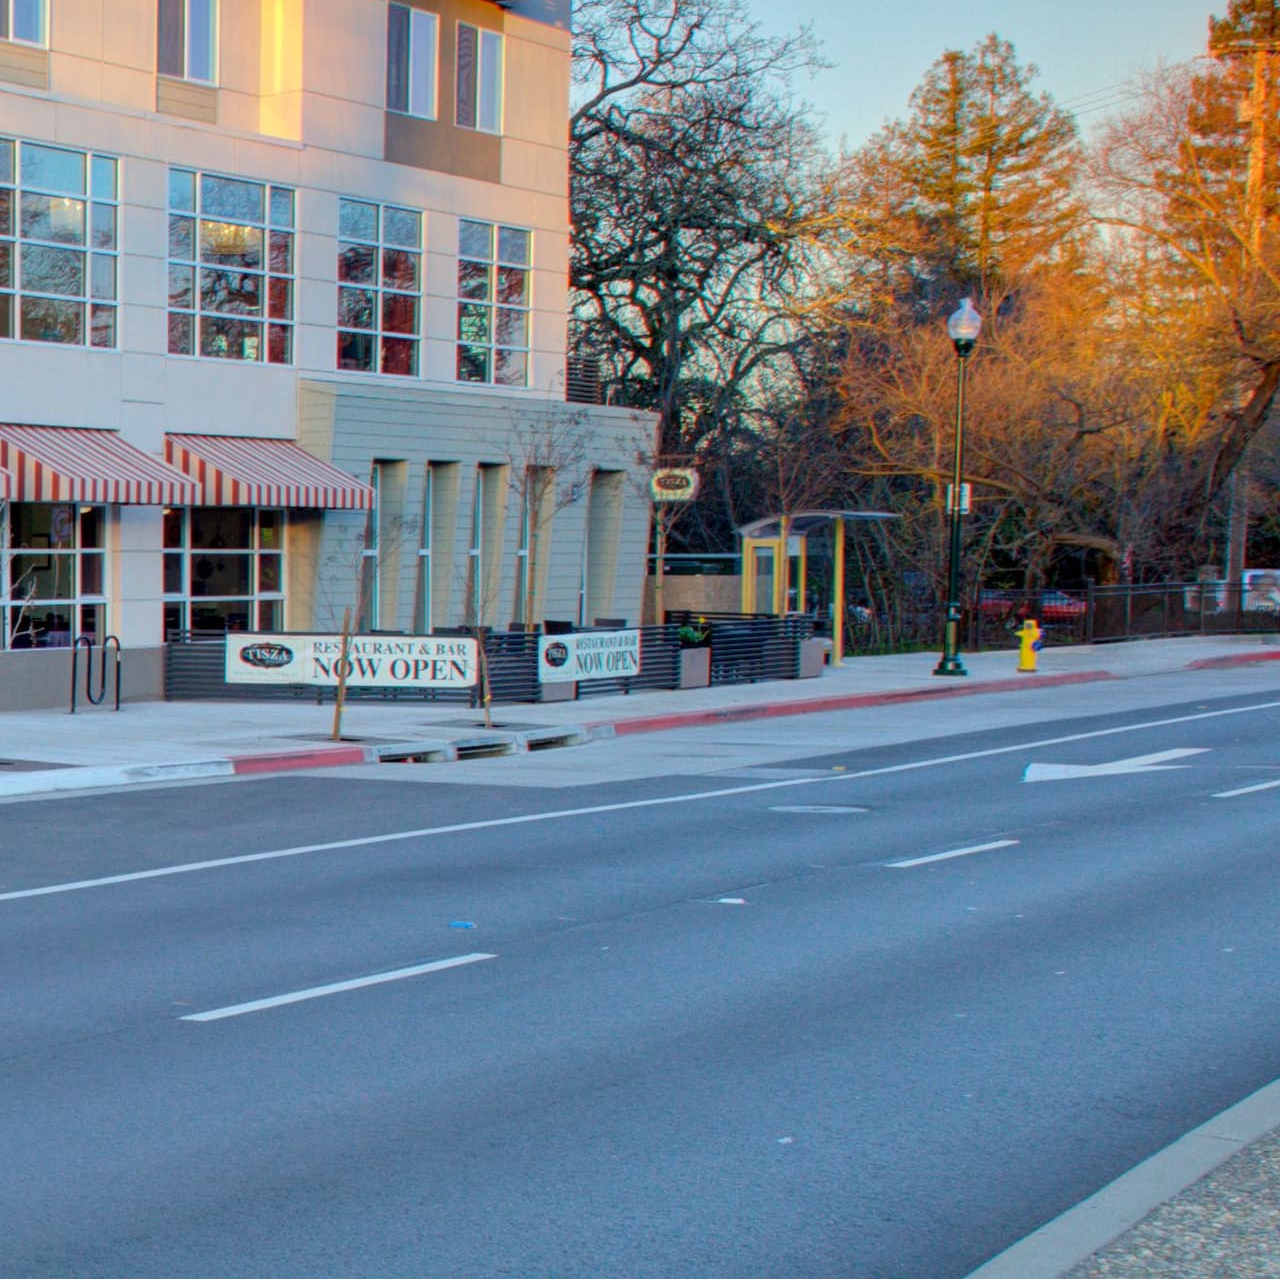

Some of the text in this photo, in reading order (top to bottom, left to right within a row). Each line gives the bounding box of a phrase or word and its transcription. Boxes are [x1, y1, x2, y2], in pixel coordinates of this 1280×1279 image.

[243, 648, 290, 661] TISZA
[313, 641, 467, 656] RESAURANT & BAR
[313, 657, 468, 681] NOW OPEN
[575, 649, 638, 674] NOW OPEN
